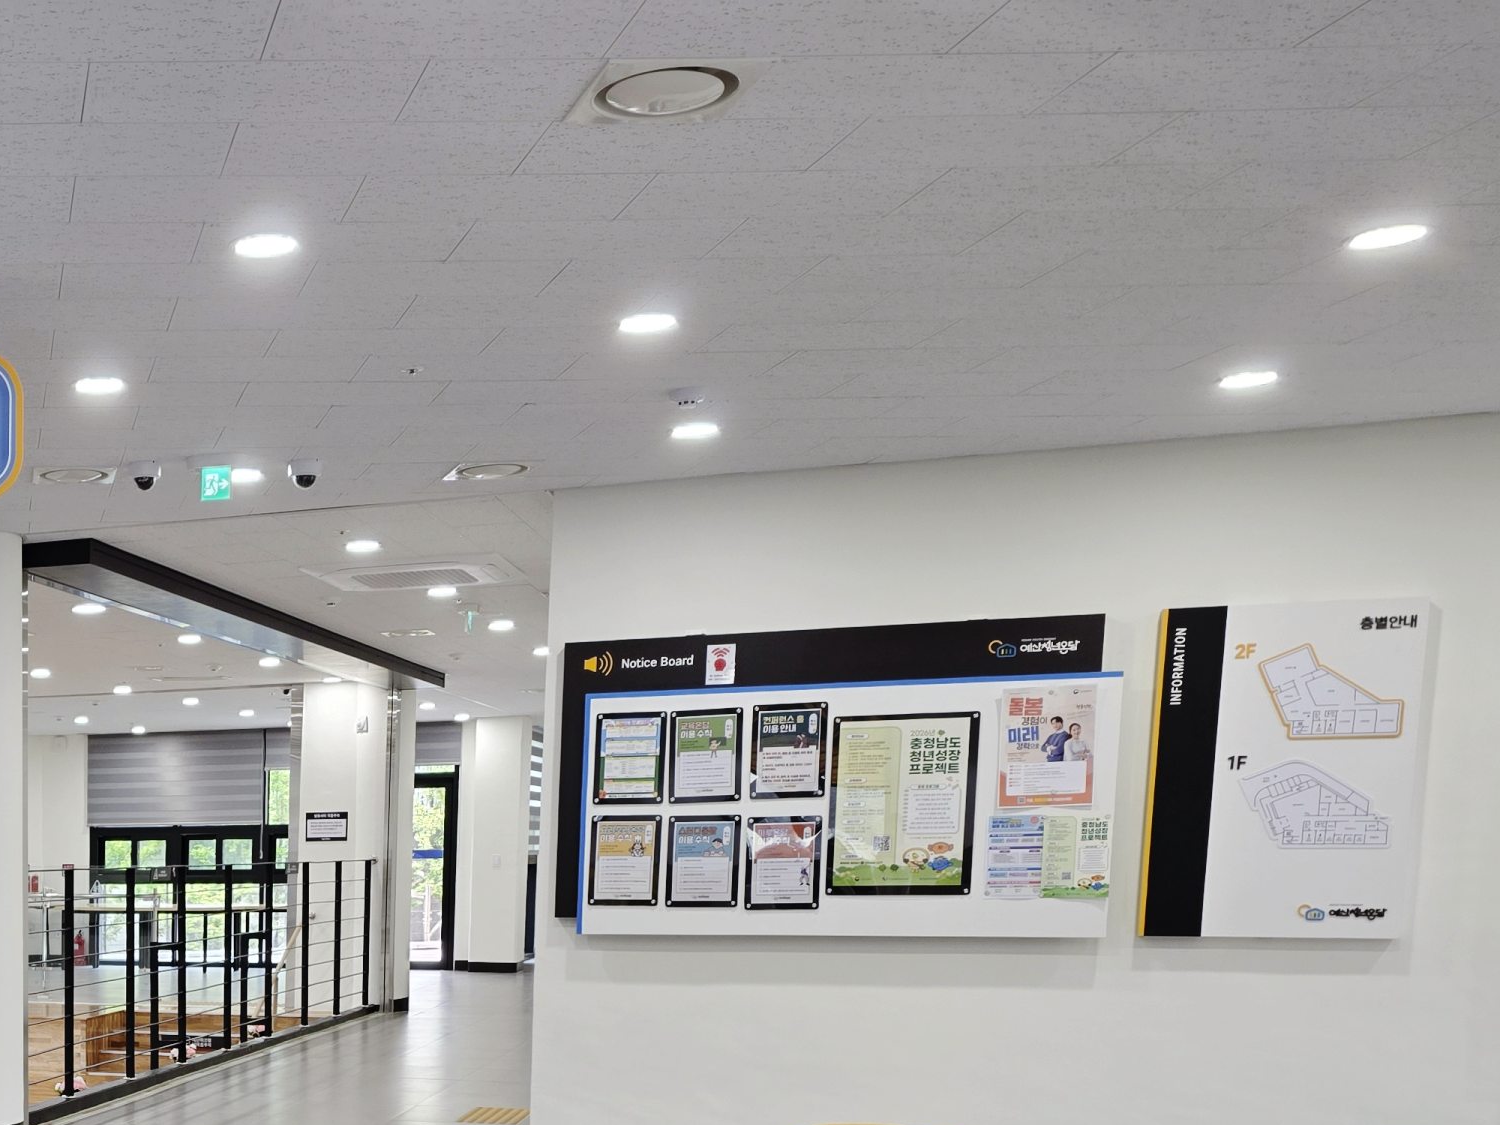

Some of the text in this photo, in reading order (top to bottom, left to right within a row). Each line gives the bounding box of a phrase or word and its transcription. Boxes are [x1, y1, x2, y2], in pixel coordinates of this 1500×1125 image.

[1360, 614, 1419, 631] 층별안내
[1234, 643, 1257, 660] 2F
[621, 654, 695, 669] Notice Board
[1169, 627, 1188, 706] INFORMATION
[1008, 697, 1044, 717] 돌봄
[762, 724, 797, 734] 이용 안내
[1008, 726, 1040, 743] 미래
[910, 737, 961, 750] 충청남도
[910, 750, 961, 762] 청년성장
[1227, 755, 1249, 771] 1F
[909, 763, 960, 775] 프로젝트
